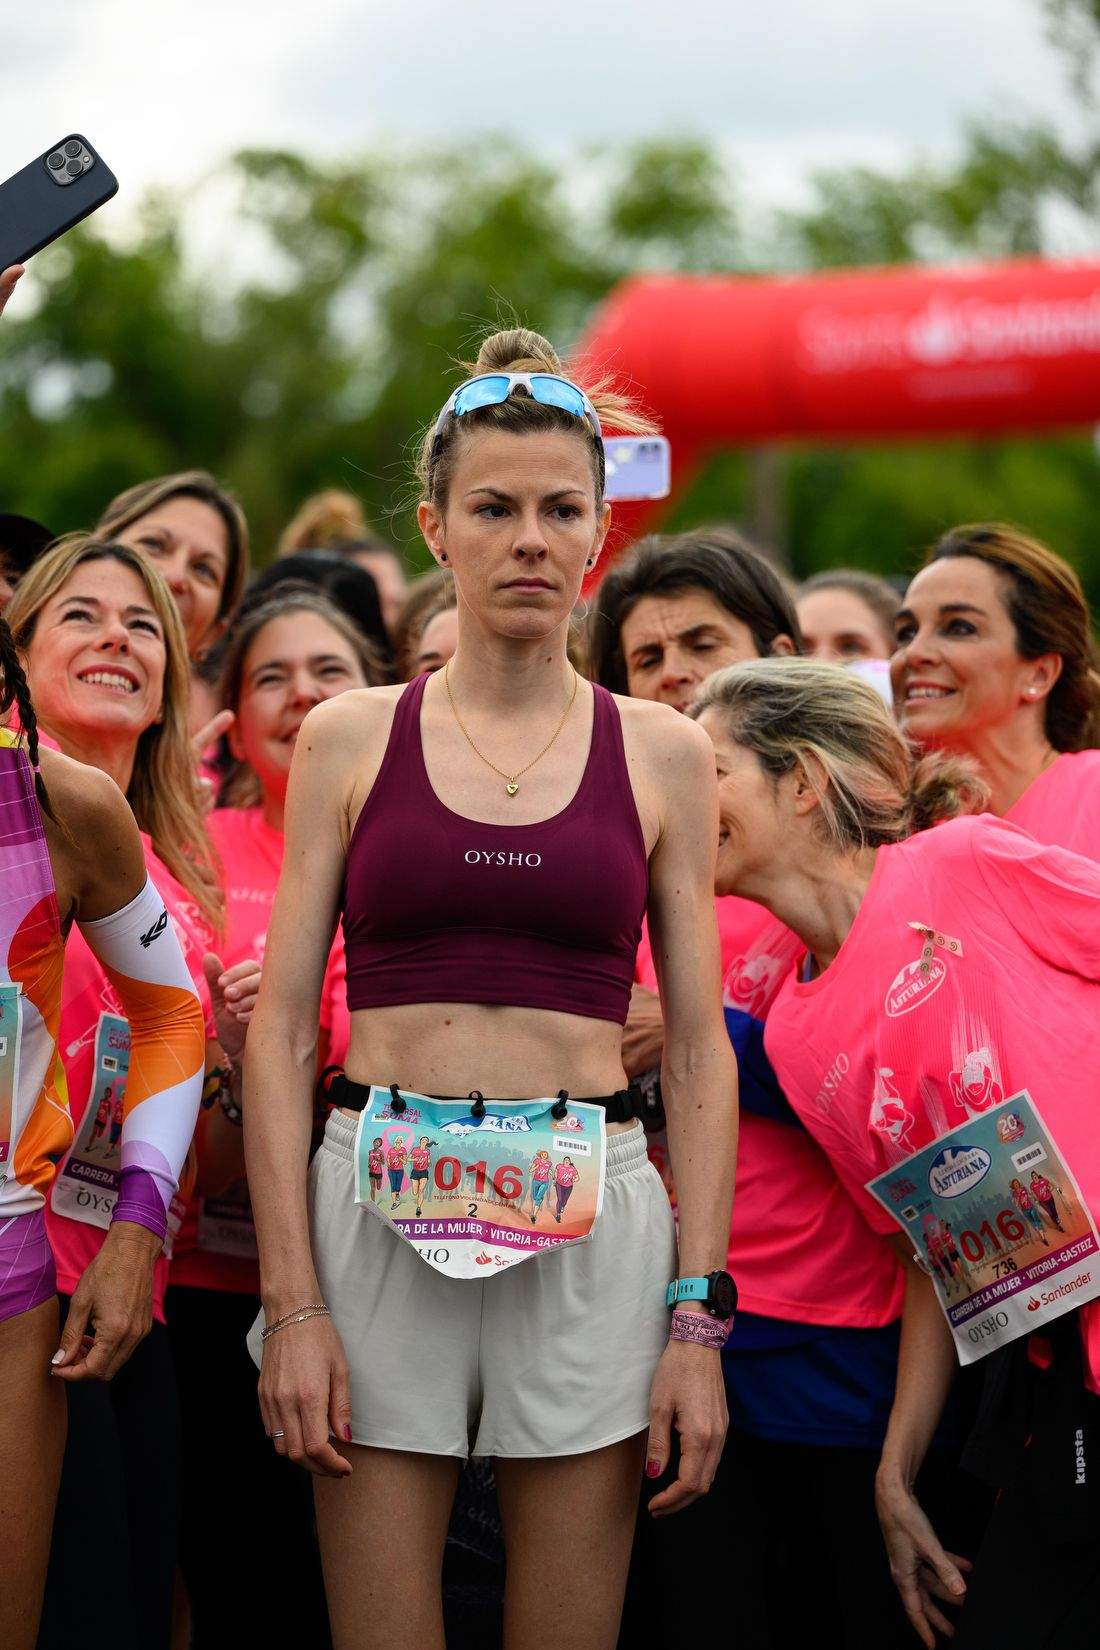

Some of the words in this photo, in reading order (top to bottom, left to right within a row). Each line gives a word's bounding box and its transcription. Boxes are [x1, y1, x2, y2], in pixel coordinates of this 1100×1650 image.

[464, 850, 541, 867] OYSHO
[889, 965, 943, 1014] ASTURINA
[71, 1163, 115, 1185] CARRERA
[434, 1156, 524, 1200] 016
[934, 1157, 988, 1195] ASTURIANA
[76, 1188, 113, 1214] OYS
[467, 1203, 478, 1218] 2
[414, 1223, 428, 1234] DE
[431, 1223, 444, 1234] LA
[447, 1222, 483, 1236] MUJER
[959, 1209, 1025, 1263] 016
[982, 1291, 993, 1304] LA
[993, 1276, 1022, 1298] MUJER
[1026, 1237, 1093, 1280] VITORIA-GASTEIZ
[992, 1258, 1018, 1279] 736
[1041, 1271, 1092, 1306] Santander
[968, 1311, 1009, 1343] OYSHO
[1075, 1429, 1086, 1484] kipsta
